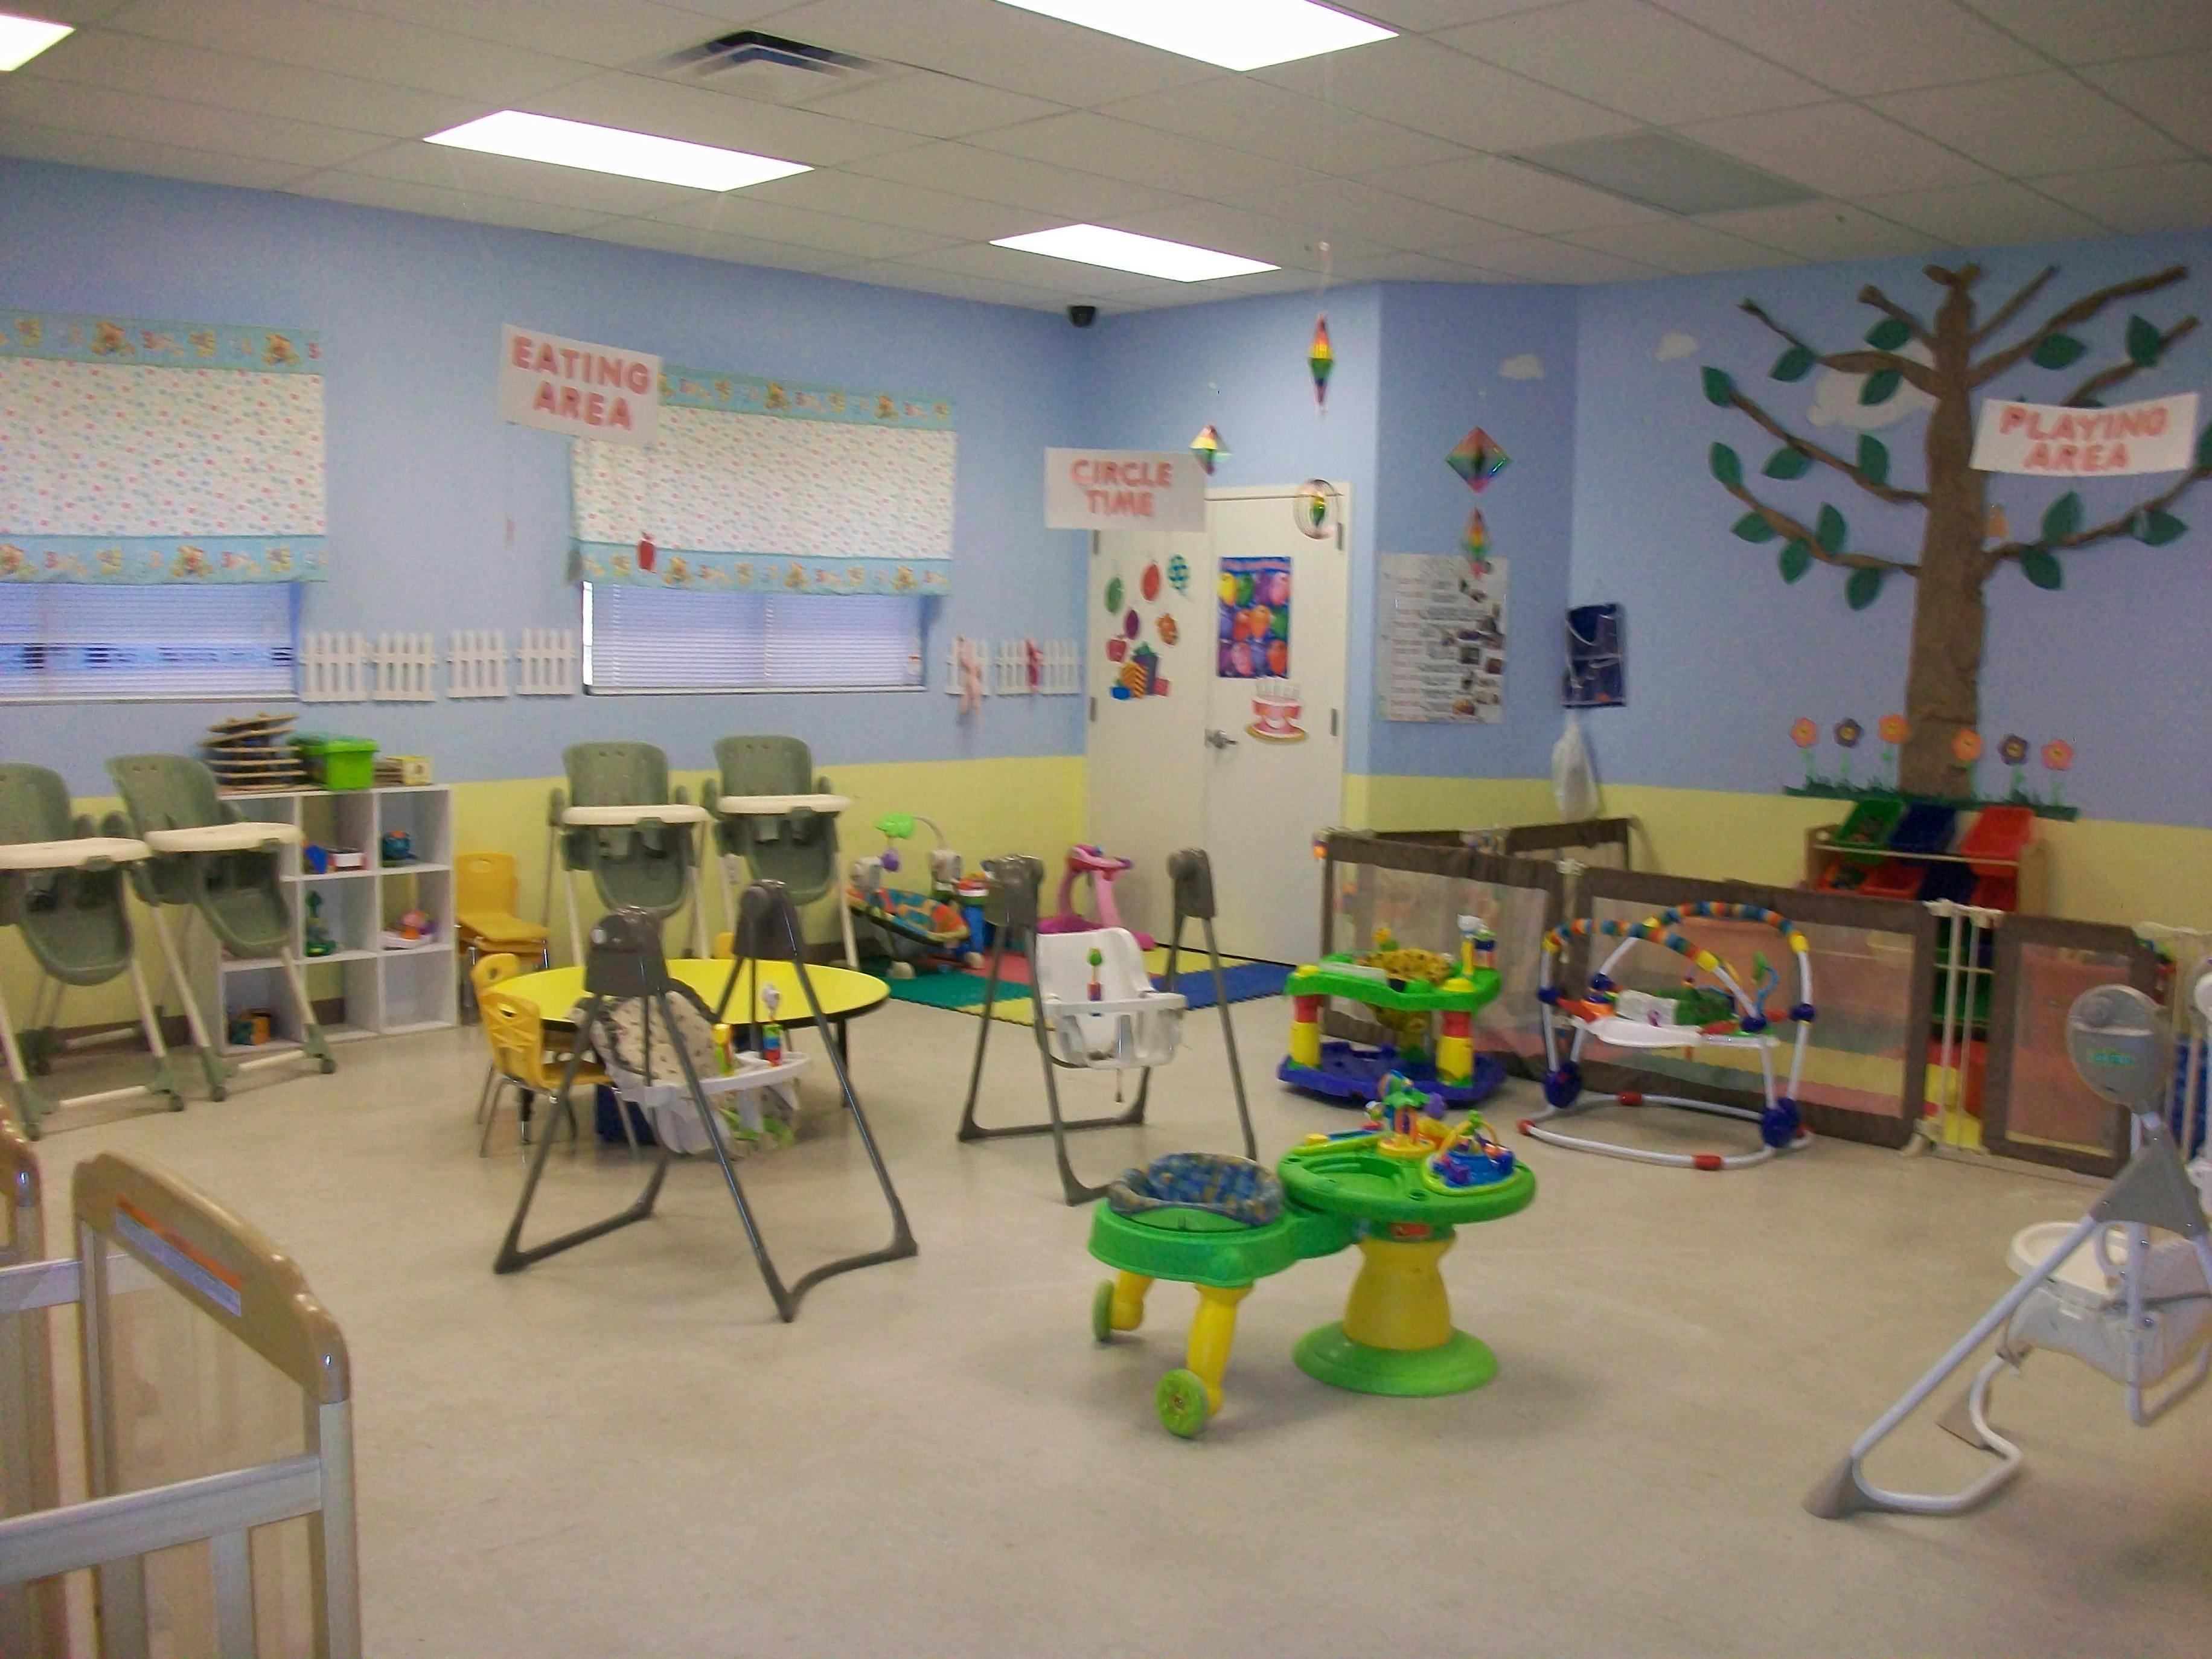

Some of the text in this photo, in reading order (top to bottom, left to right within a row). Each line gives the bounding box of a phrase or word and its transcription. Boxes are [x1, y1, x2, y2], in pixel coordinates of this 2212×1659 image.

[512, 335, 648, 395] EATING
[534, 380, 631, 430] AREA
[1999, 405, 2169, 441] PLAYING
[1069, 458, 1173, 488] CIRCLE
[2024, 443, 2129, 471] AREA
[1084, 490, 1155, 517] TIME
